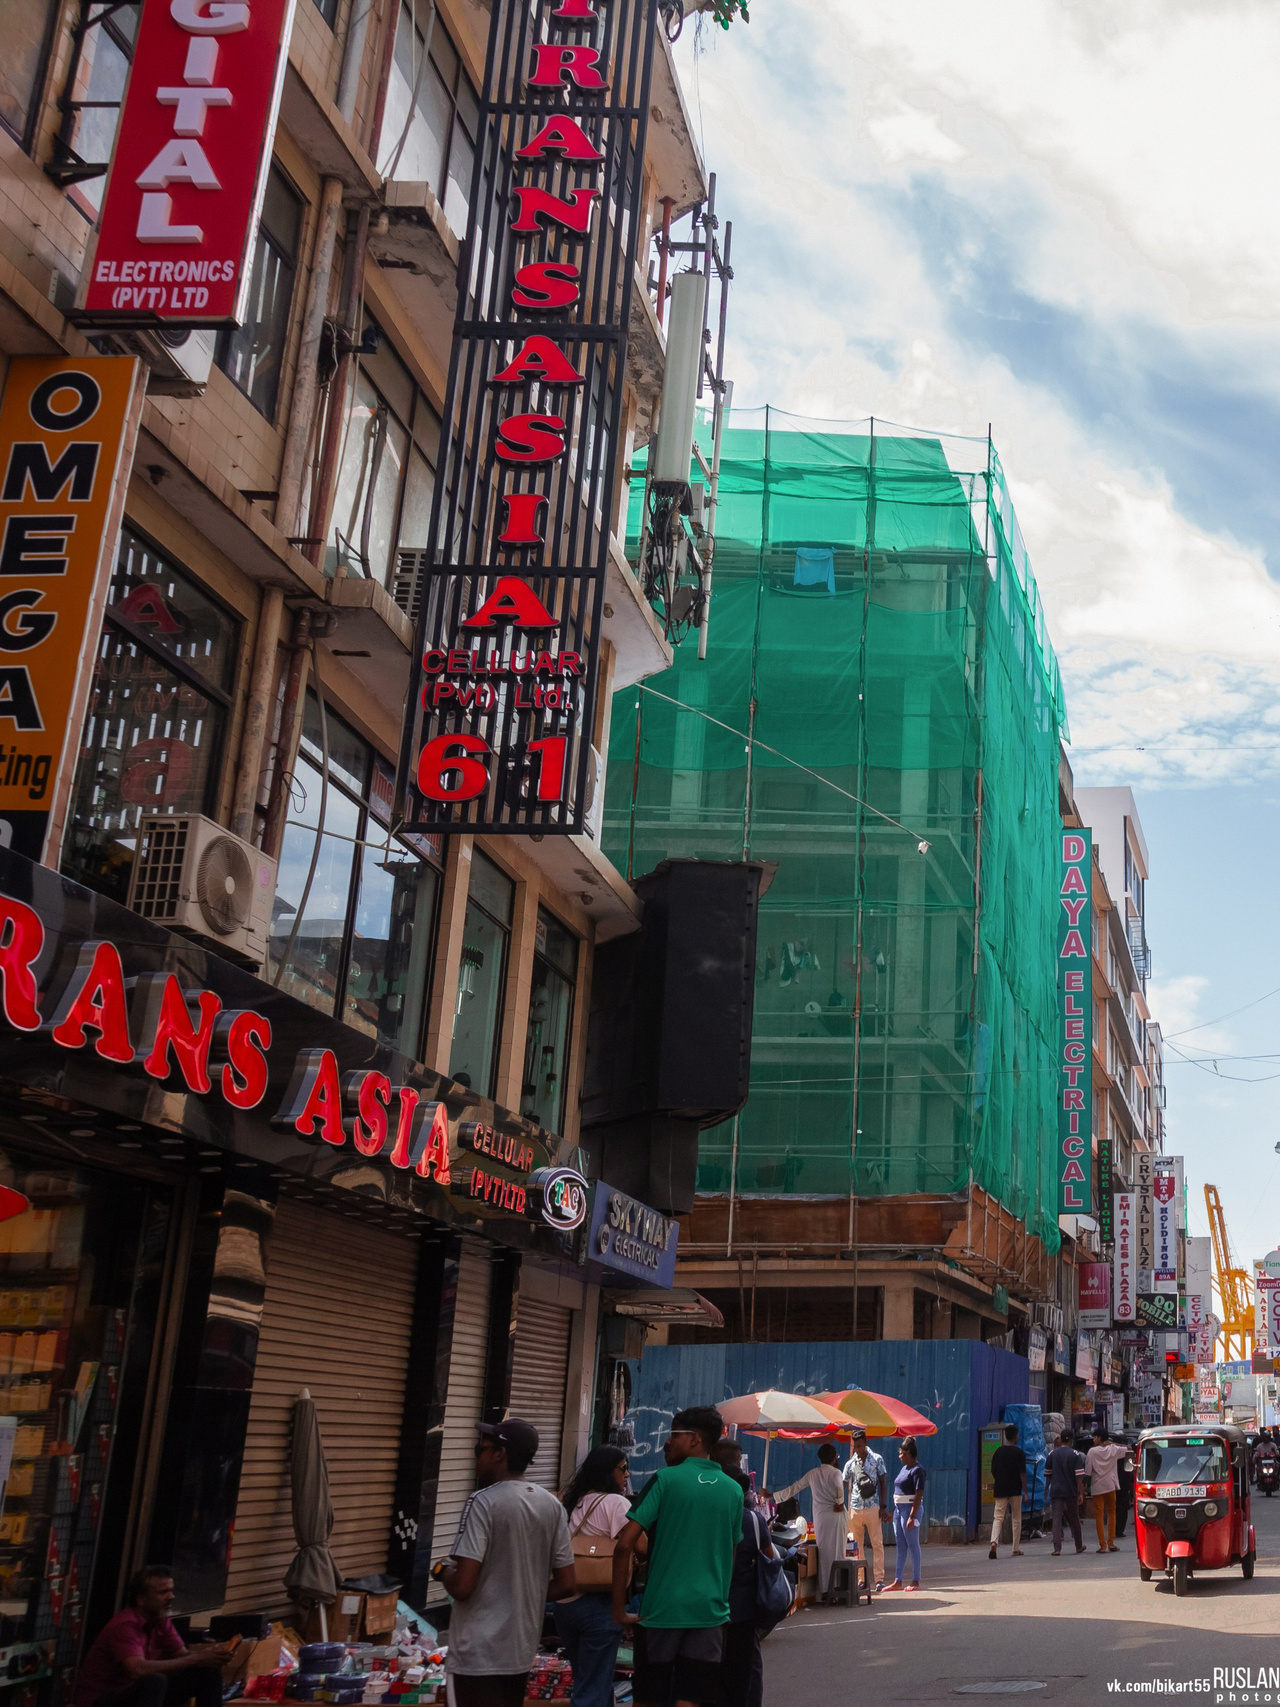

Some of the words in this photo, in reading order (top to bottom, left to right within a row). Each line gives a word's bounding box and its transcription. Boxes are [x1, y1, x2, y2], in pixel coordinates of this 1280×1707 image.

[95, 260, 235, 283] ELECTRONICS
[111, 287, 167, 309] (PVT)
[171, 287, 209, 309] LTD
[461, 334, 586, 629] ASIA
[0, 370, 101, 732] OMEGA
[422, 650, 582, 675] CELLUAR
[421, 682, 496, 712] (Pvt)
[514, 684, 573, 709] Ltd.
[1060, 835, 1088, 958] DAYA
[1061, 971, 1086, 1208] ELECTRICAL
[296, 1049, 452, 1185] ASIA
[473, 1121, 534, 1174] CELLULAR
[1101, 1142, 1110, 1187] NATURE
[555, 1179, 580, 1211] TAC
[1139, 1155, 1150, 1223] CRYSTAL
[1160, 1178, 1169, 1200] MTM
[610, 1193, 674, 1252] SKYWAY
[1101, 1194, 1111, 1240] LIGHTS
[1119, 1195, 1131, 1259] EMIRATES
[1160, 1207, 1169, 1268] HOLDINGS
[615, 1235, 661, 1270] ELECTRICALS
[1139, 1228, 1150, 1270] PLAZ
[1120, 1263, 1130, 1301] PLAZA
[1119, 1306, 1131, 1314] 83
[1191, 1296, 1202, 1325] CCTV
[1260, 1297, 1268, 1329] ASIA
[1256, 1338, 1268, 1347] 13
